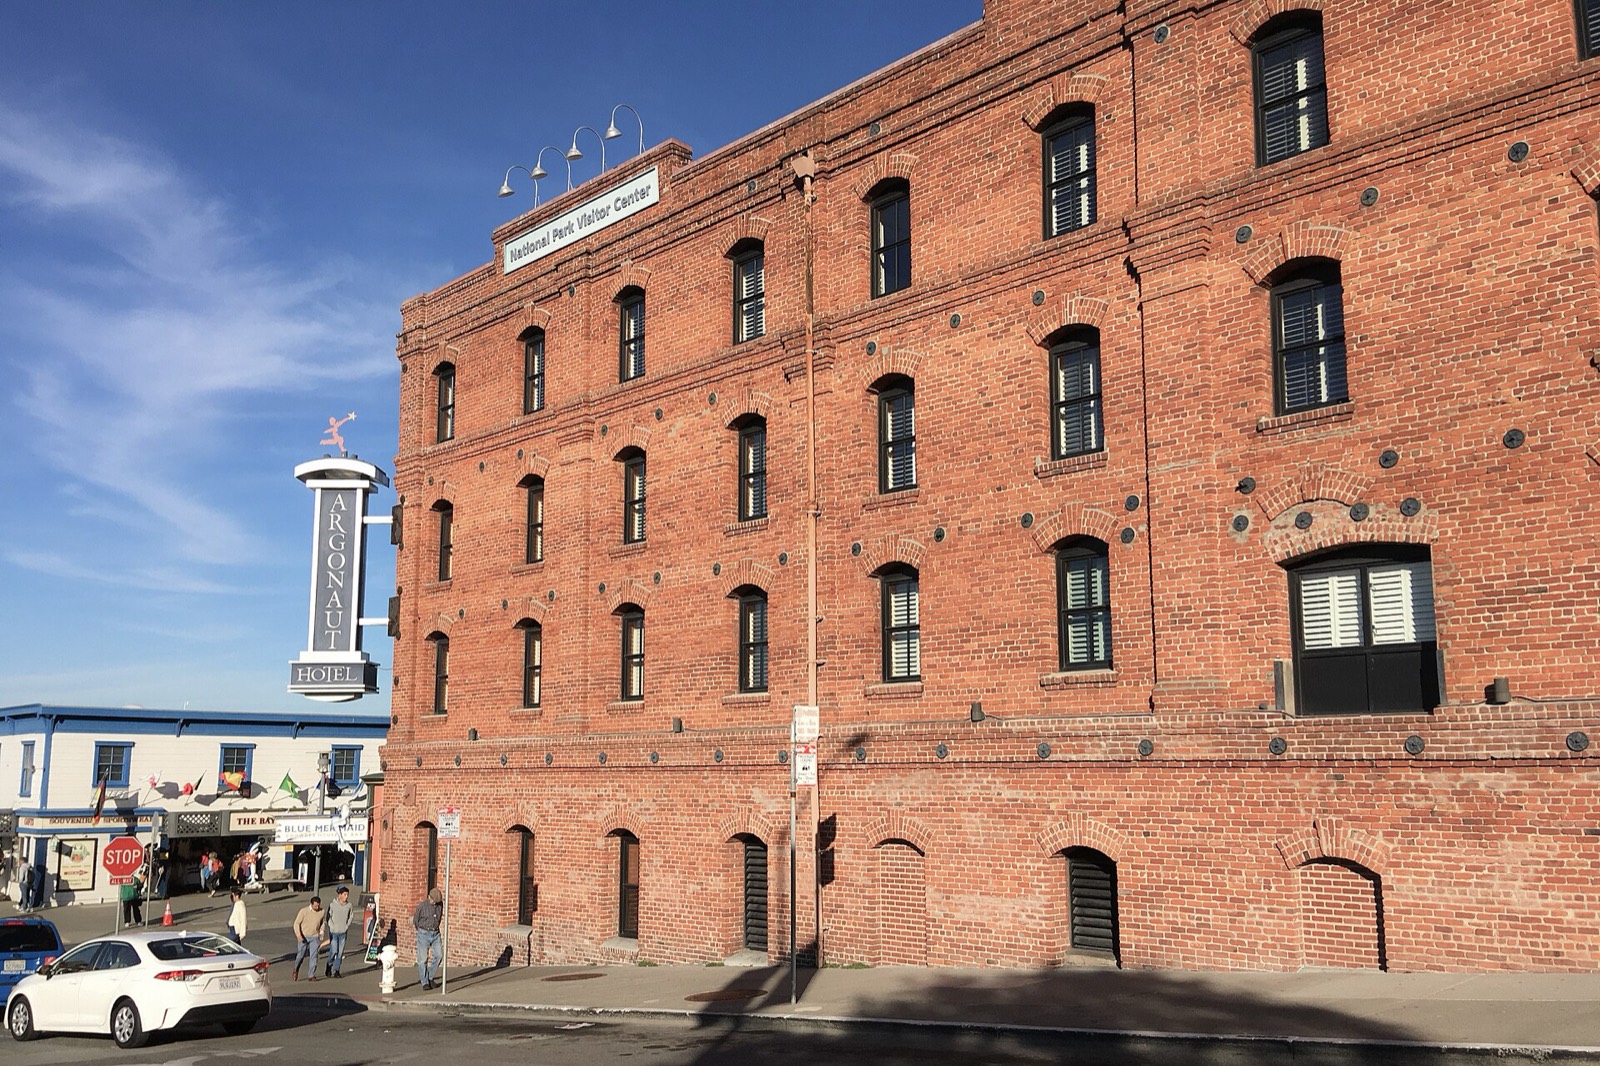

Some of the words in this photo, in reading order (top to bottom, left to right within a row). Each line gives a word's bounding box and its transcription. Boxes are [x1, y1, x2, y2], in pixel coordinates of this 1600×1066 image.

[509, 231, 550, 263] National
[552, 220, 575, 243] Park
[576, 205, 611, 230] Visitor
[613, 184, 651, 212] Center
[325, 493, 347, 650] ARGONAUT
[296, 666, 358, 682] HOTEL
[237, 817, 257, 825] THE
[259, 816, 276, 824] BAY
[284, 824, 311, 833] BLUE
[105, 849, 141, 865] STOP
